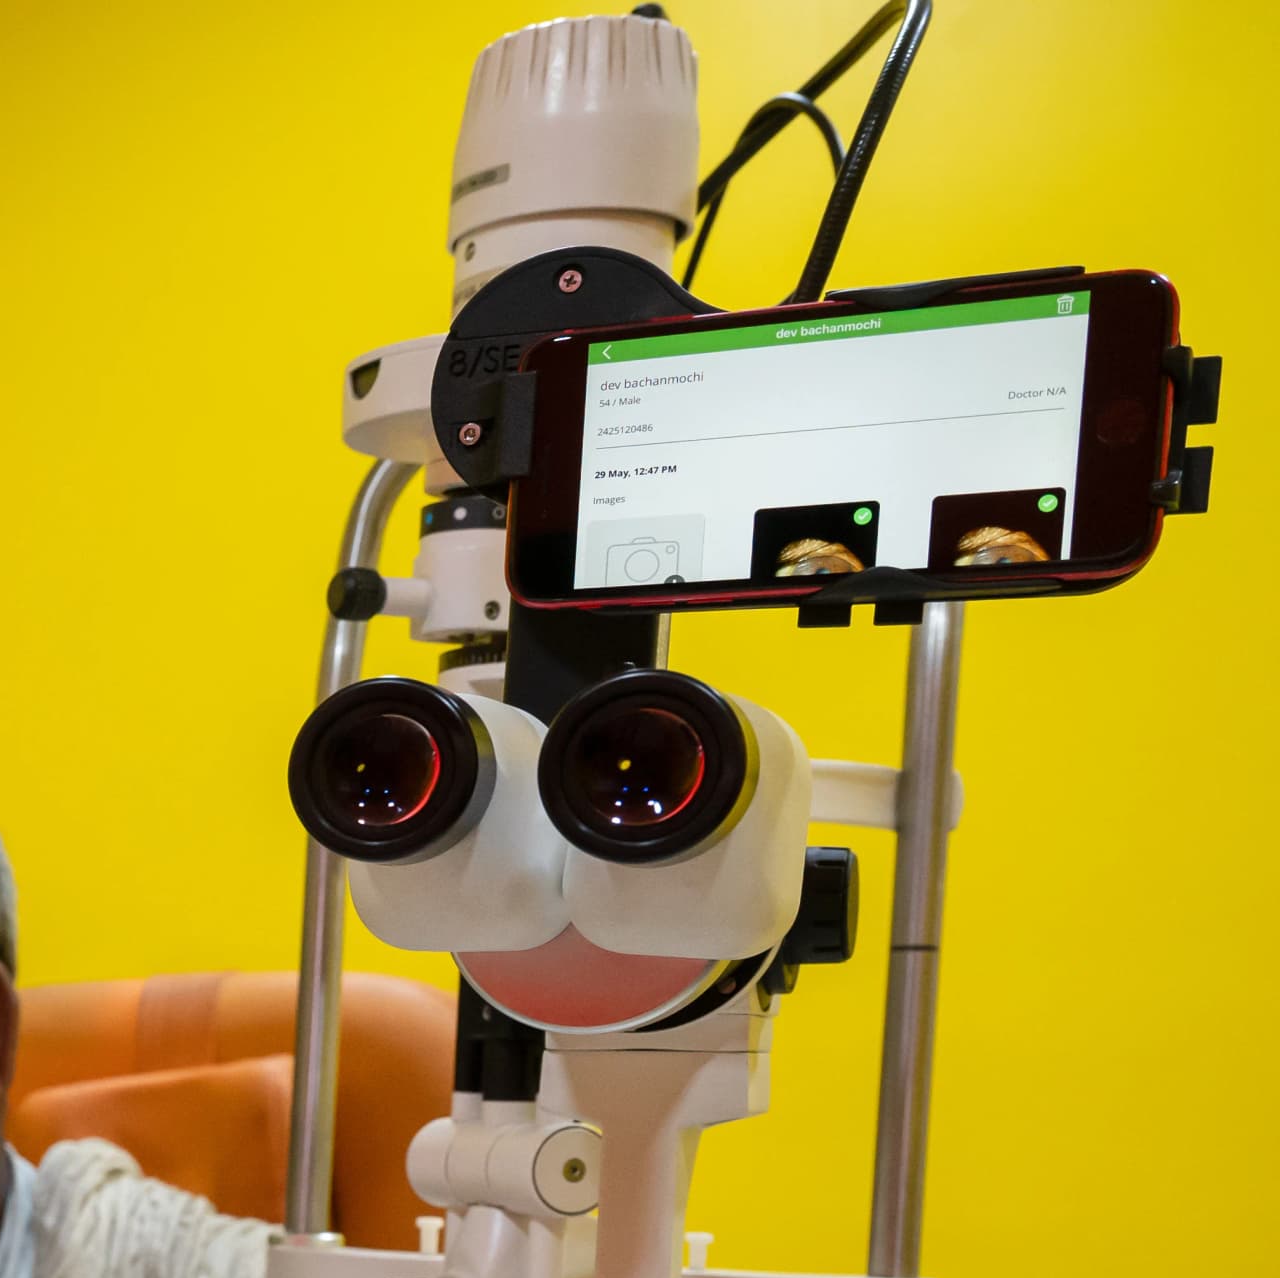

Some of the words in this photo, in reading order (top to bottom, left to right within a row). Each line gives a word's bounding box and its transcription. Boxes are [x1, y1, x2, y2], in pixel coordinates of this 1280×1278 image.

[775, 327, 798, 339] dev
[800, 318, 882, 337] bachanmochi
[600, 380, 622, 392] dev
[624, 370, 705, 390] bachanmochi
[1008, 390, 1044, 400] Doctor
[1046, 386, 1067, 397] N/A
[599, 399, 611, 408] 54
[619, 395, 642, 407] Male
[597, 423, 654, 437] 2425120486
[594, 471, 606, 480] 29
[608, 468, 631, 480] May,
[634, 466, 659, 477] 12:47
[661, 464, 678, 474] PM
[593, 495, 627, 506] Images
